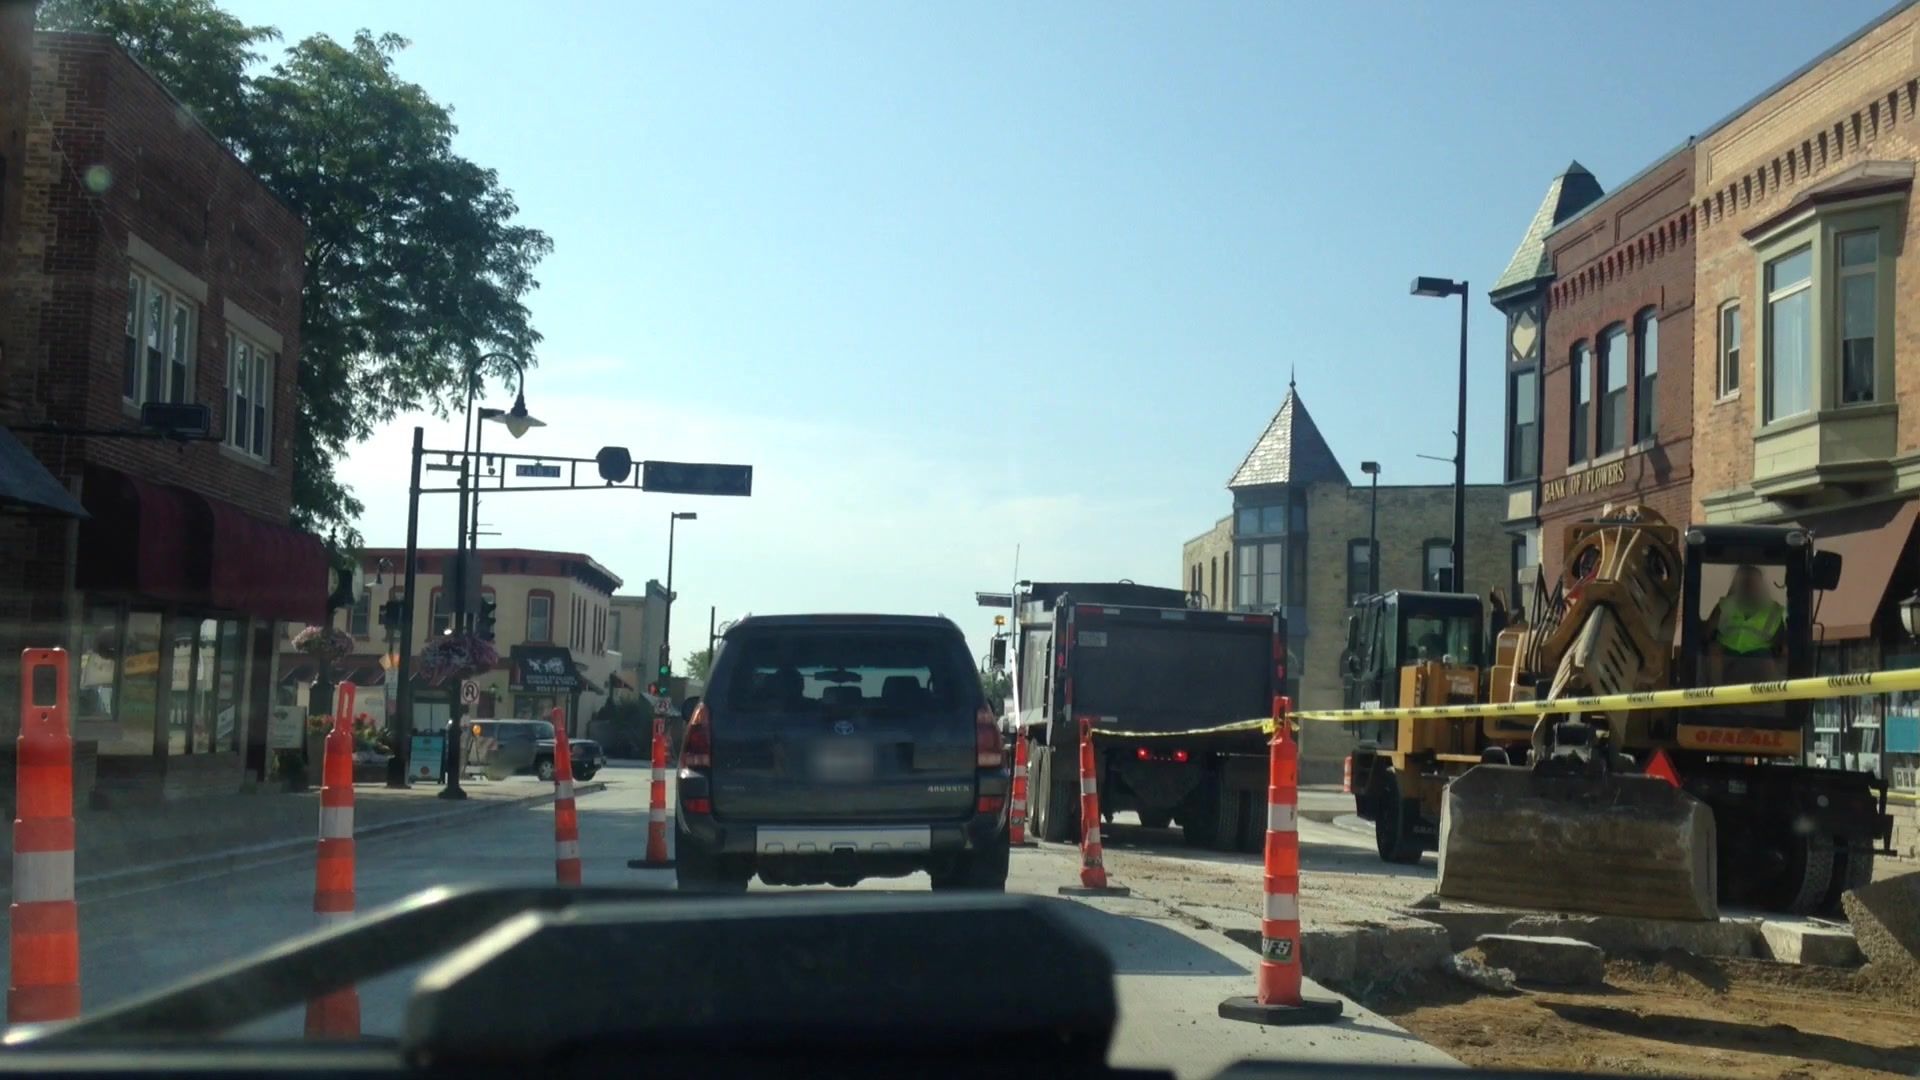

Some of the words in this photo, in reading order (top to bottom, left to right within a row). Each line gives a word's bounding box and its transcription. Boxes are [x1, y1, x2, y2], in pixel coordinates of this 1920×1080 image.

[1544, 480, 1567, 503] BANK
[1571, 474, 1581, 496] OF
[1586, 461, 1625, 492] FLOWERS
